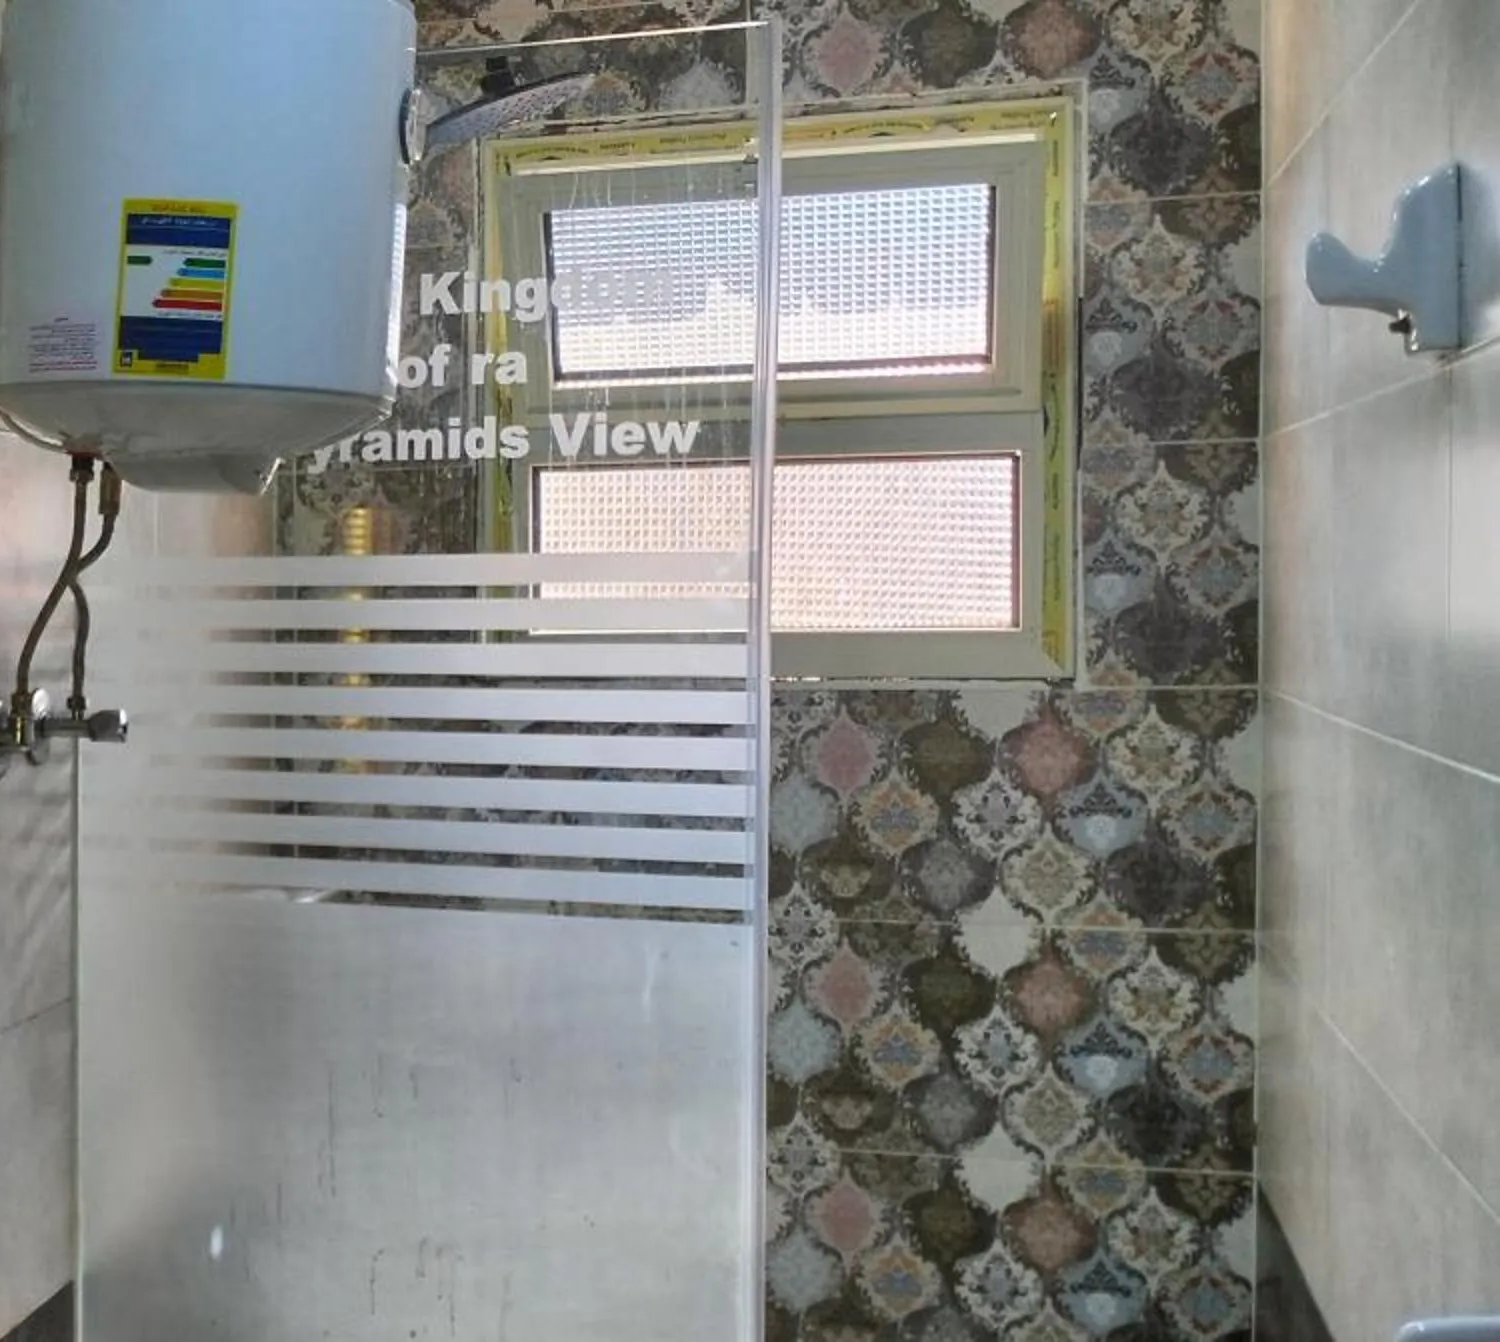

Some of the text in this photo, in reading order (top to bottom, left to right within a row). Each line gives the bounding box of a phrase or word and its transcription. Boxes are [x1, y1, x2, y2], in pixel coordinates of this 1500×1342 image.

[399, 343, 527, 388] of ra
[308, 411, 700, 474] yramids View
